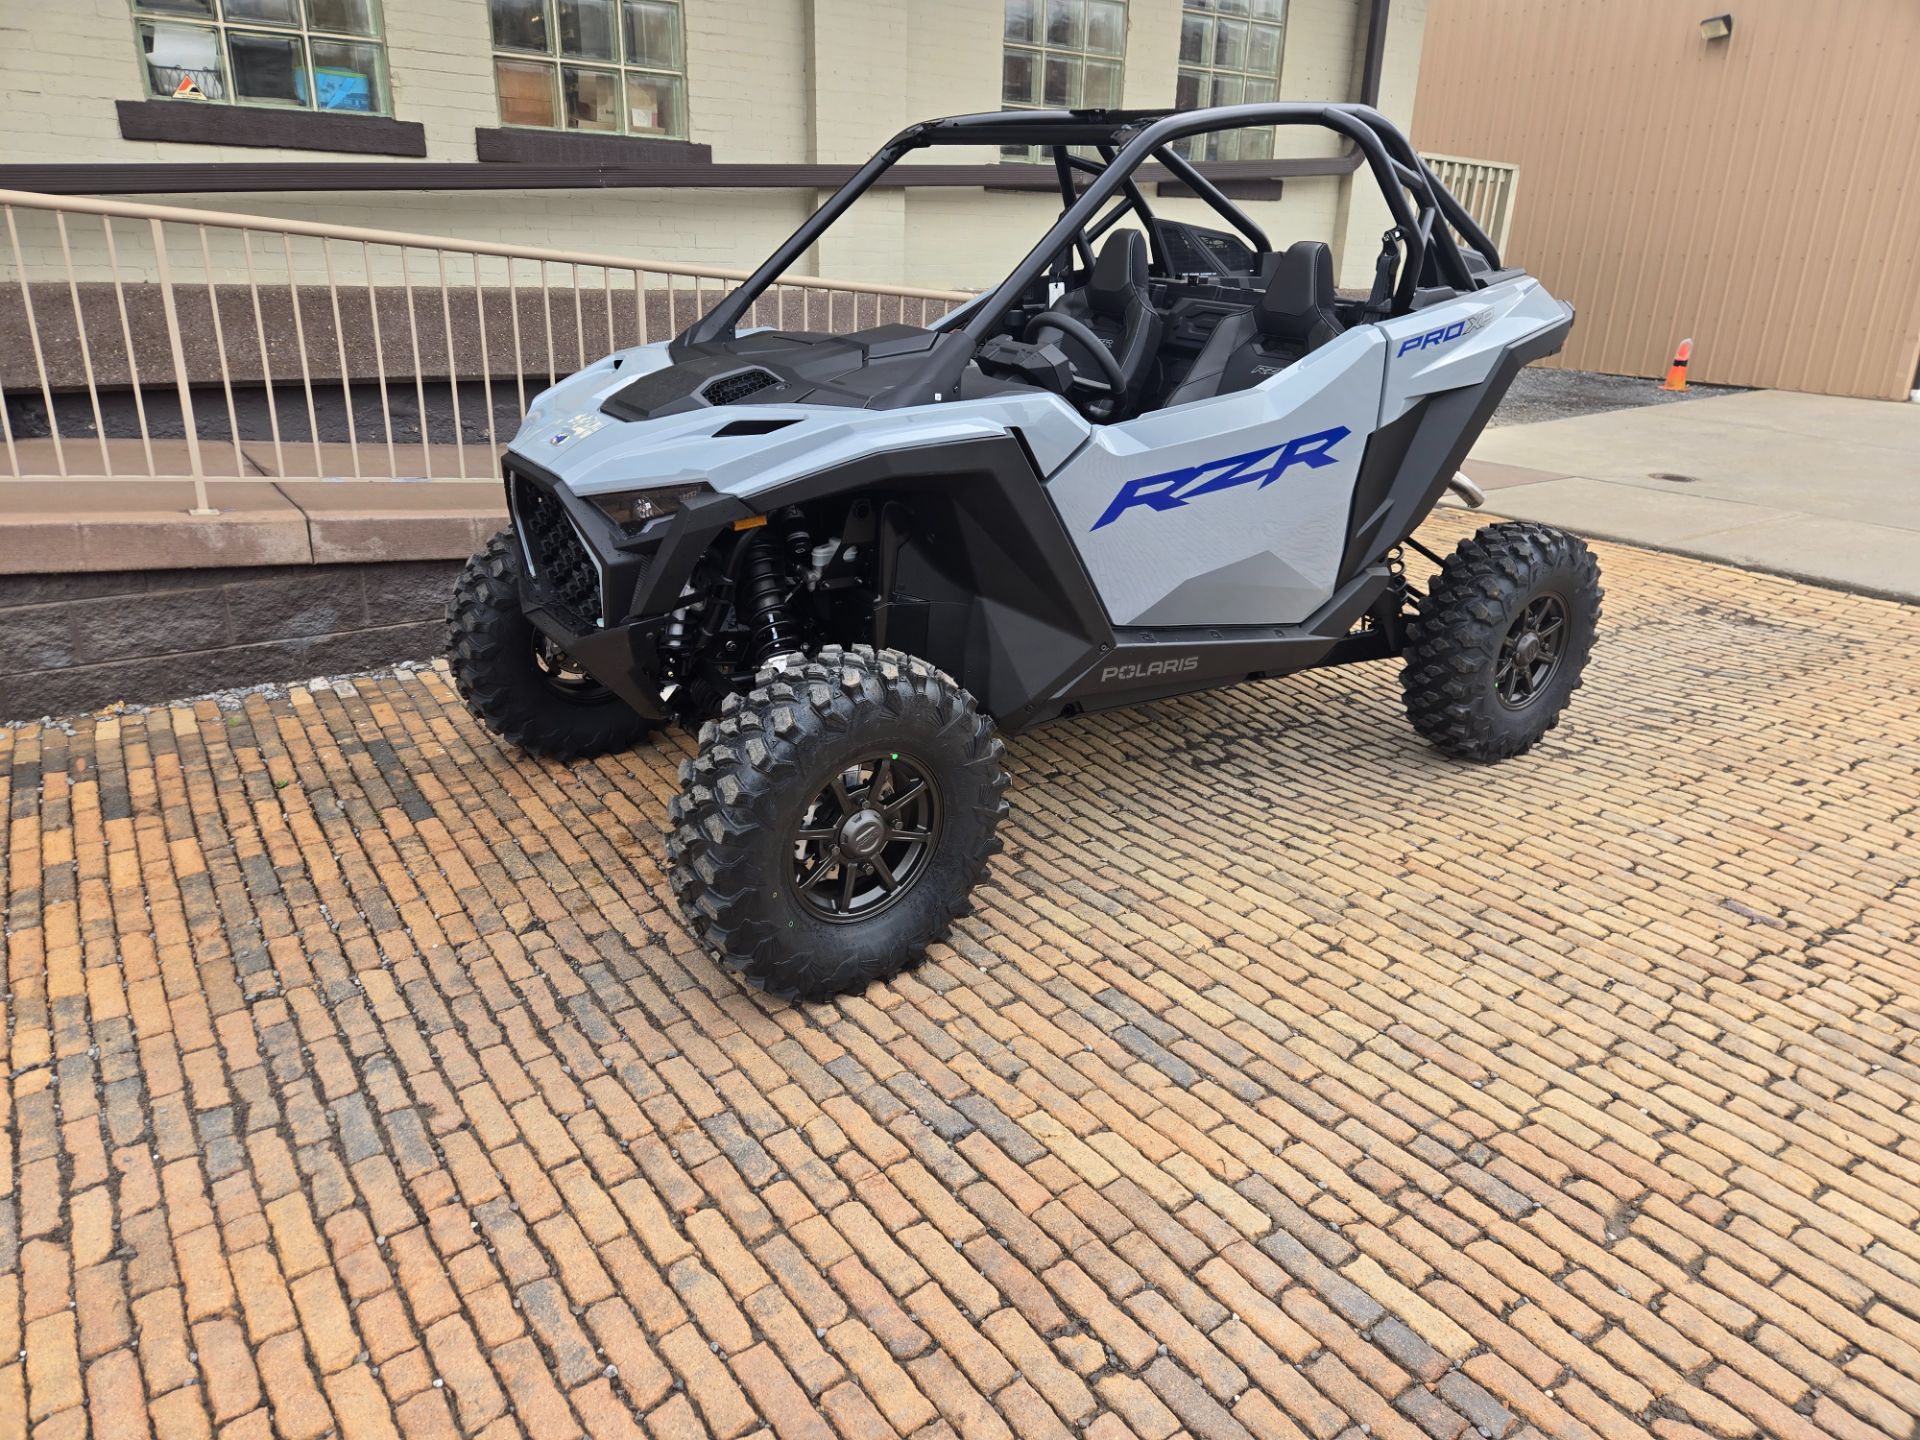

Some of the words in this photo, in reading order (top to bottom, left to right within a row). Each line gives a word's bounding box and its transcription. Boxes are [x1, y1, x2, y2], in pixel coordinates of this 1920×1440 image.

[1397, 320, 1465, 358] PRO
[1089, 425, 1351, 532] RZR
[1101, 656, 1199, 682] POLARIS
